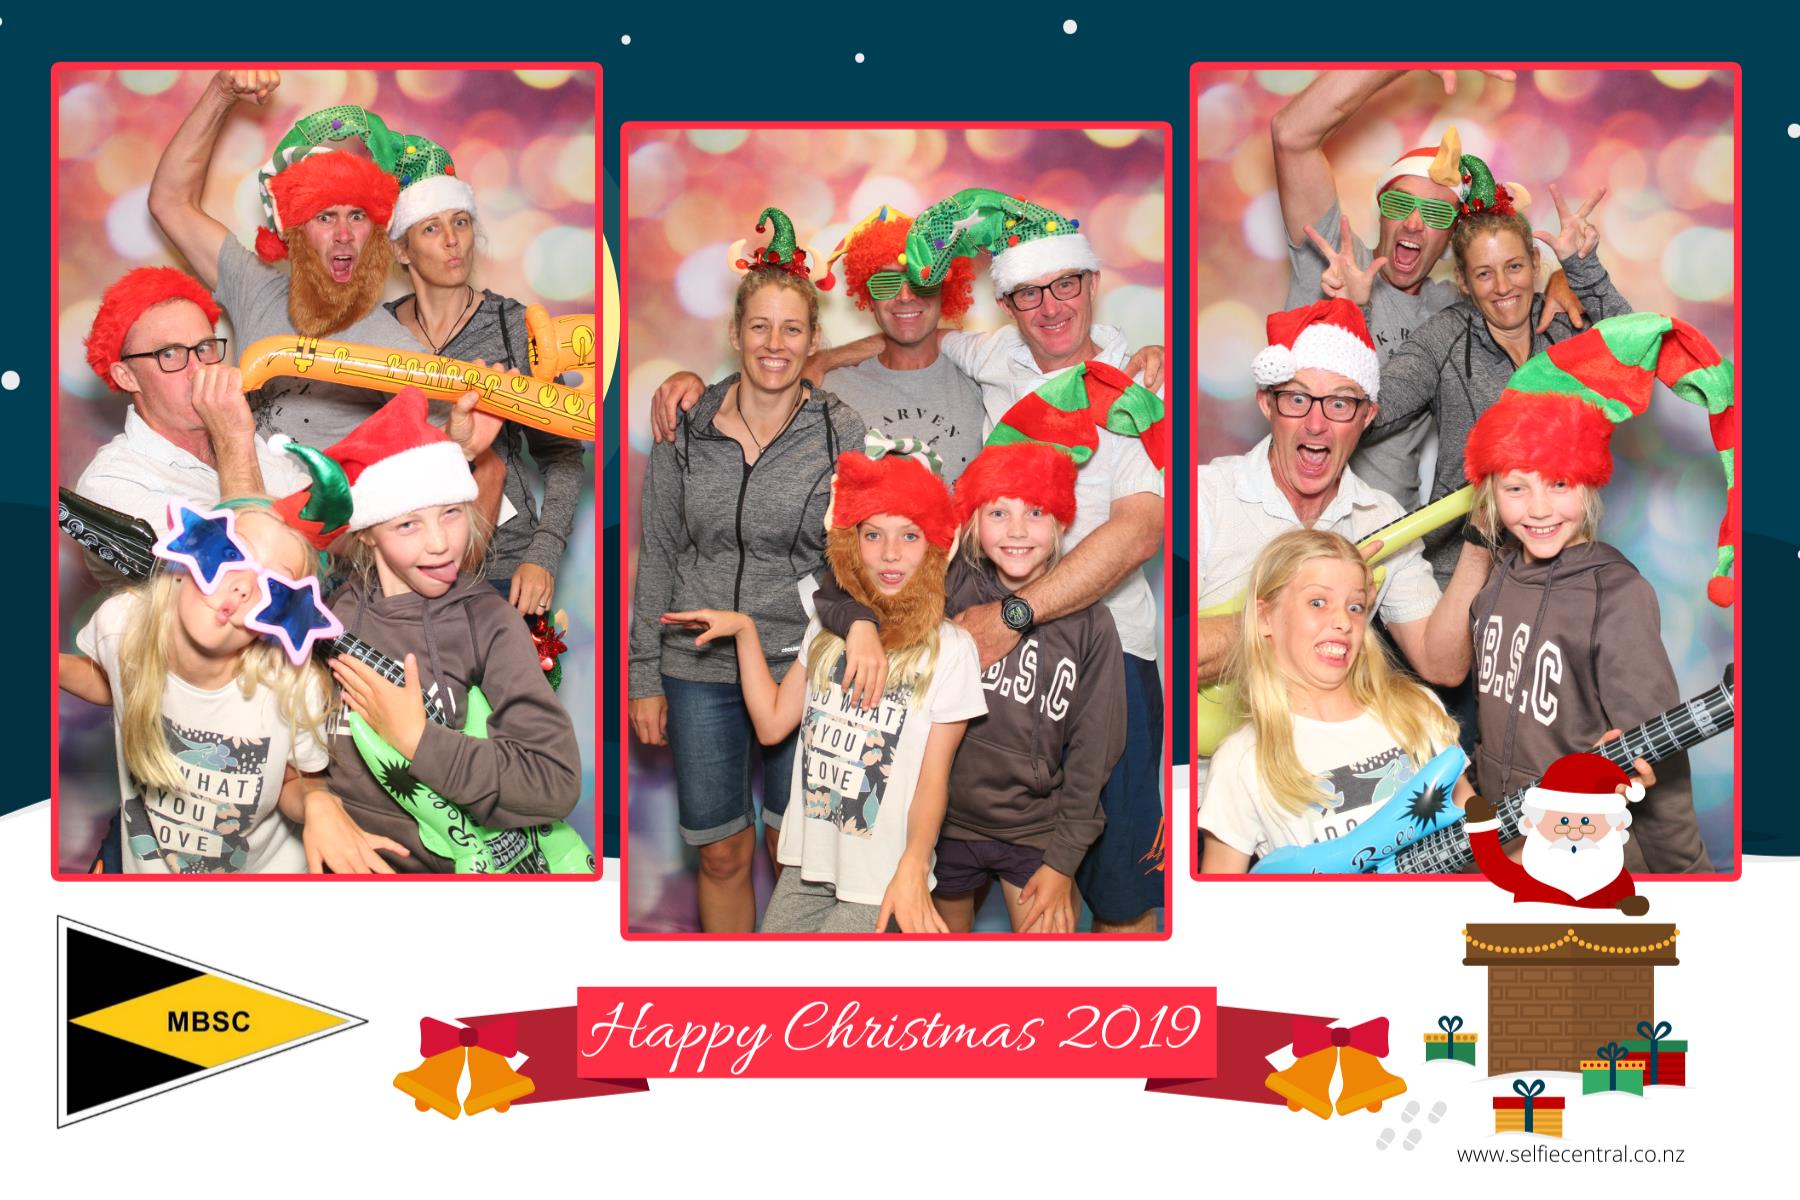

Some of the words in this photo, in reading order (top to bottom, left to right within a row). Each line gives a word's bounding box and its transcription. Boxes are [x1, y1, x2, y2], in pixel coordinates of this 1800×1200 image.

[821, 723, 857, 752] YOU
[807, 754, 853, 791] LOVE
[157, 788, 206, 822] YOU
